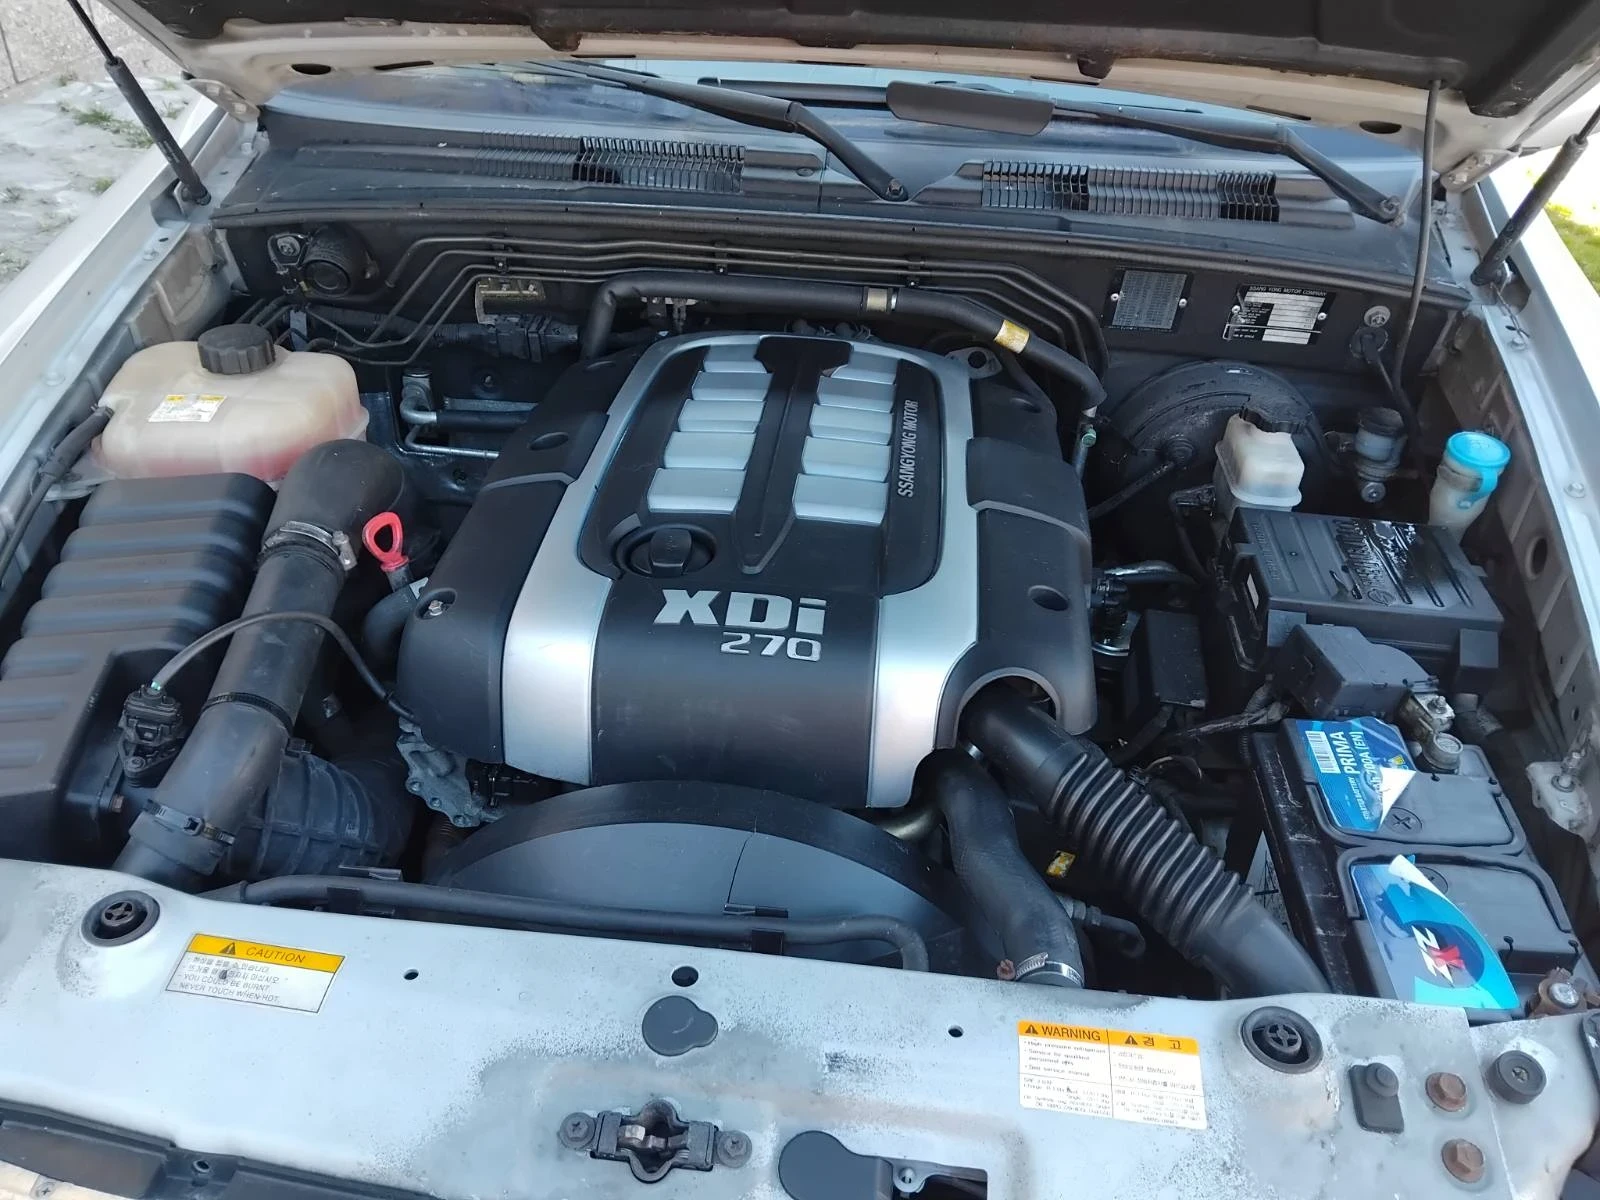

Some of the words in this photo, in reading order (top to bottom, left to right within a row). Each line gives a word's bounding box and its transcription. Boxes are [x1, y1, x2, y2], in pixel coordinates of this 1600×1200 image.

[902, 399, 918, 432] MOTOR
[897, 432, 917, 498] SSANGYONG
[653, 588, 827, 636] XDi
[720, 631, 822, 662] 270
[1329, 730, 1361, 775] PRIMA
[1348, 775, 1361, 796] BATTERY
[245, 947, 306, 963] CAUTION
[180, 982, 205, 991] NEVER
[208, 985, 234, 995] TOUCH
[236, 990, 260, 1000] WHEN
[184, 973, 199, 981] YOU
[202, 975, 228, 985] COULD
[1041, 1025, 1101, 1041] WARNING
